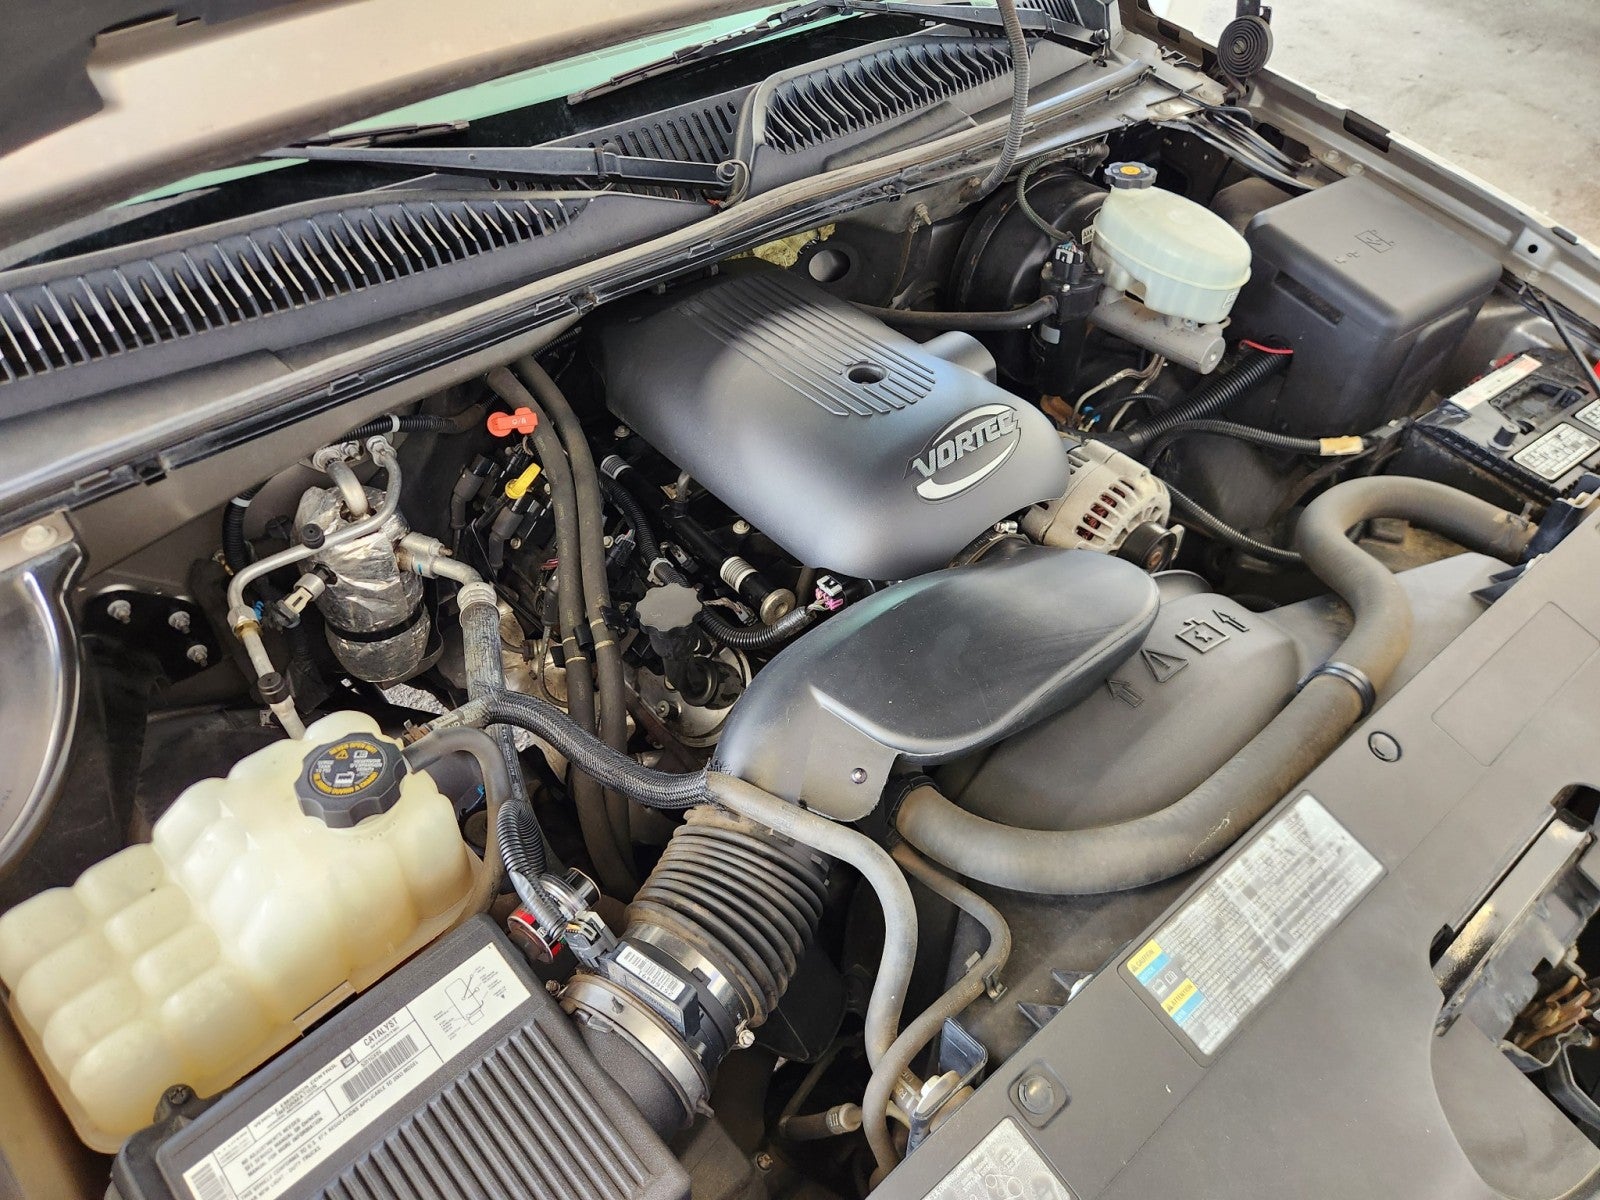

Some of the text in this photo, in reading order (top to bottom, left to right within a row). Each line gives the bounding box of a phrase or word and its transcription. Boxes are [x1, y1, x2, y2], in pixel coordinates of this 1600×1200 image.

[911, 409, 1018, 478] VORTEC
[1170, 983, 1193, 1006] ATTENTION
[363, 1017, 398, 1047] CATALYST
[310, 1063, 337, 1085] CONTROL
